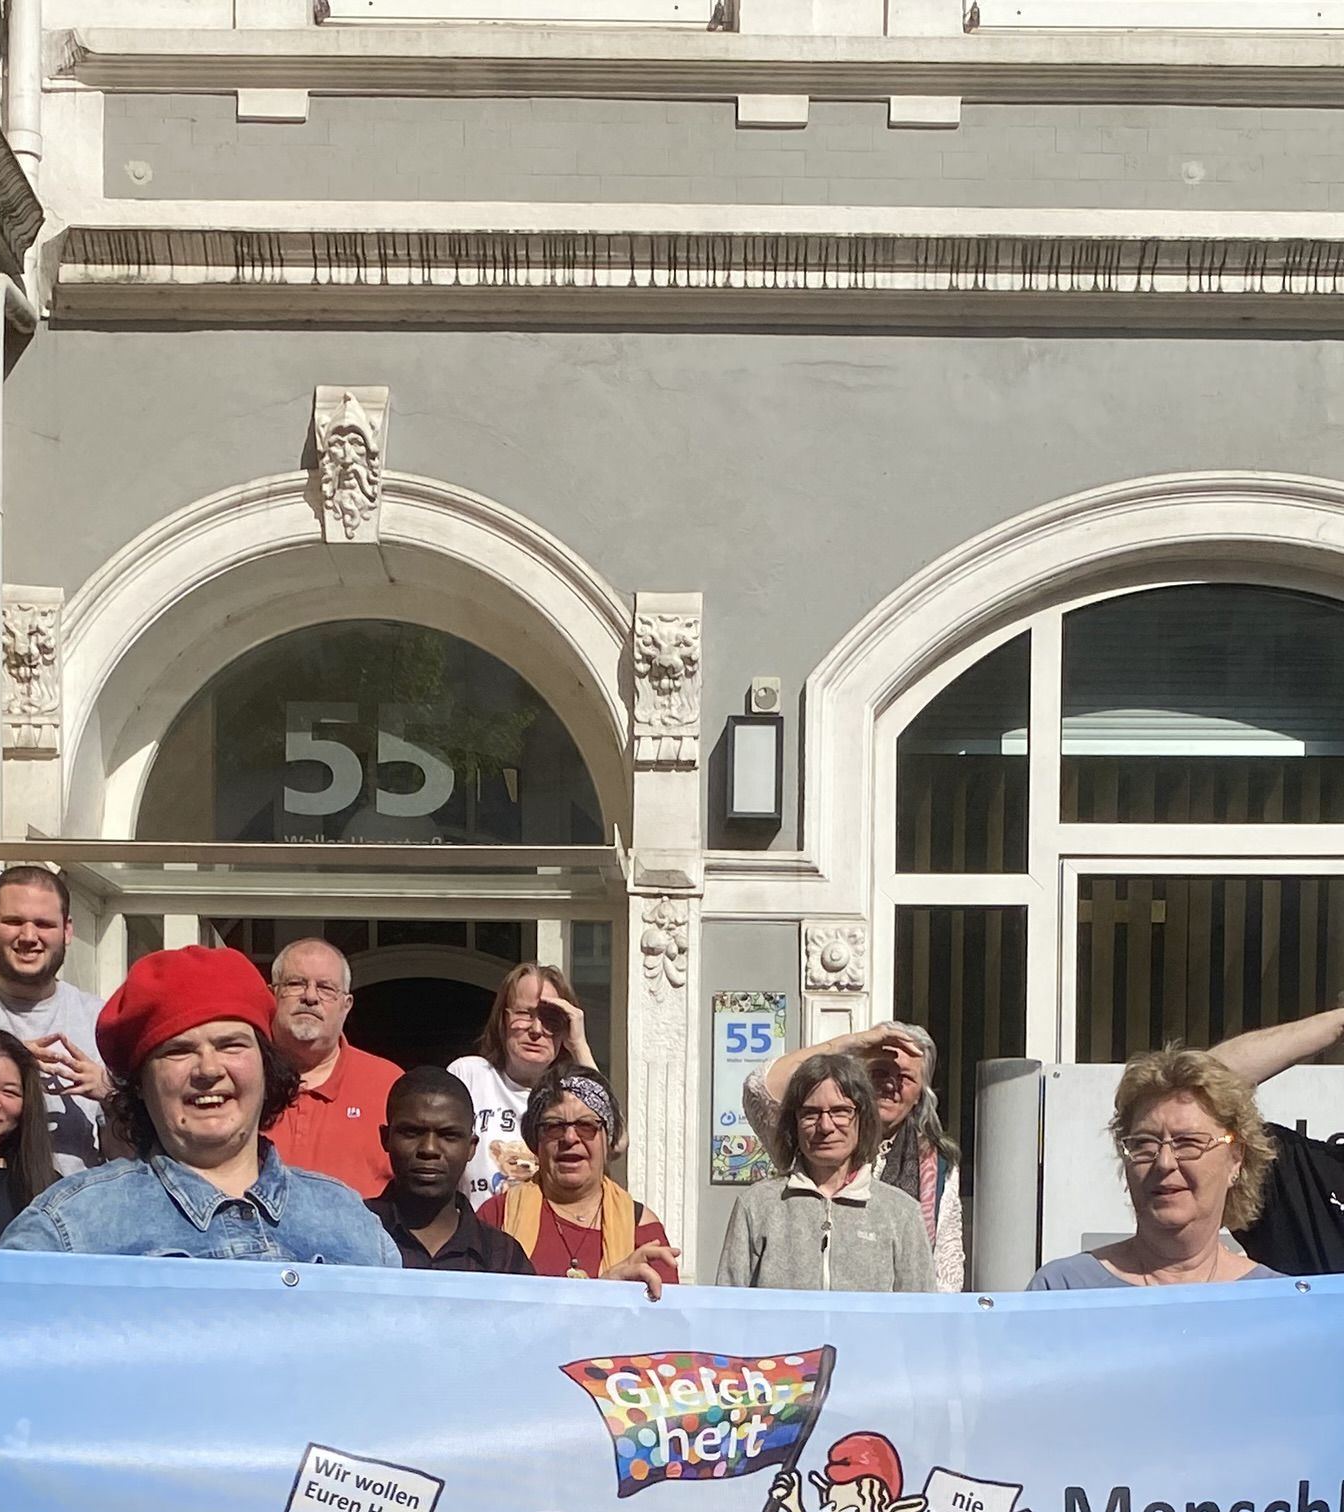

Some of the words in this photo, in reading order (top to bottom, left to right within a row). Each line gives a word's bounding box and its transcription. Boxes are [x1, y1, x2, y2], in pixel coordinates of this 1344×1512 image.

[284, 702, 455, 817] 55
[726, 1023, 772, 1053] 55
[606, 1366, 790, 1409] Gleich-
[655, 1409, 768, 1463] heit
[315, 1456, 351, 1483] Wir
[355, 1474, 420, 1510] wollen
